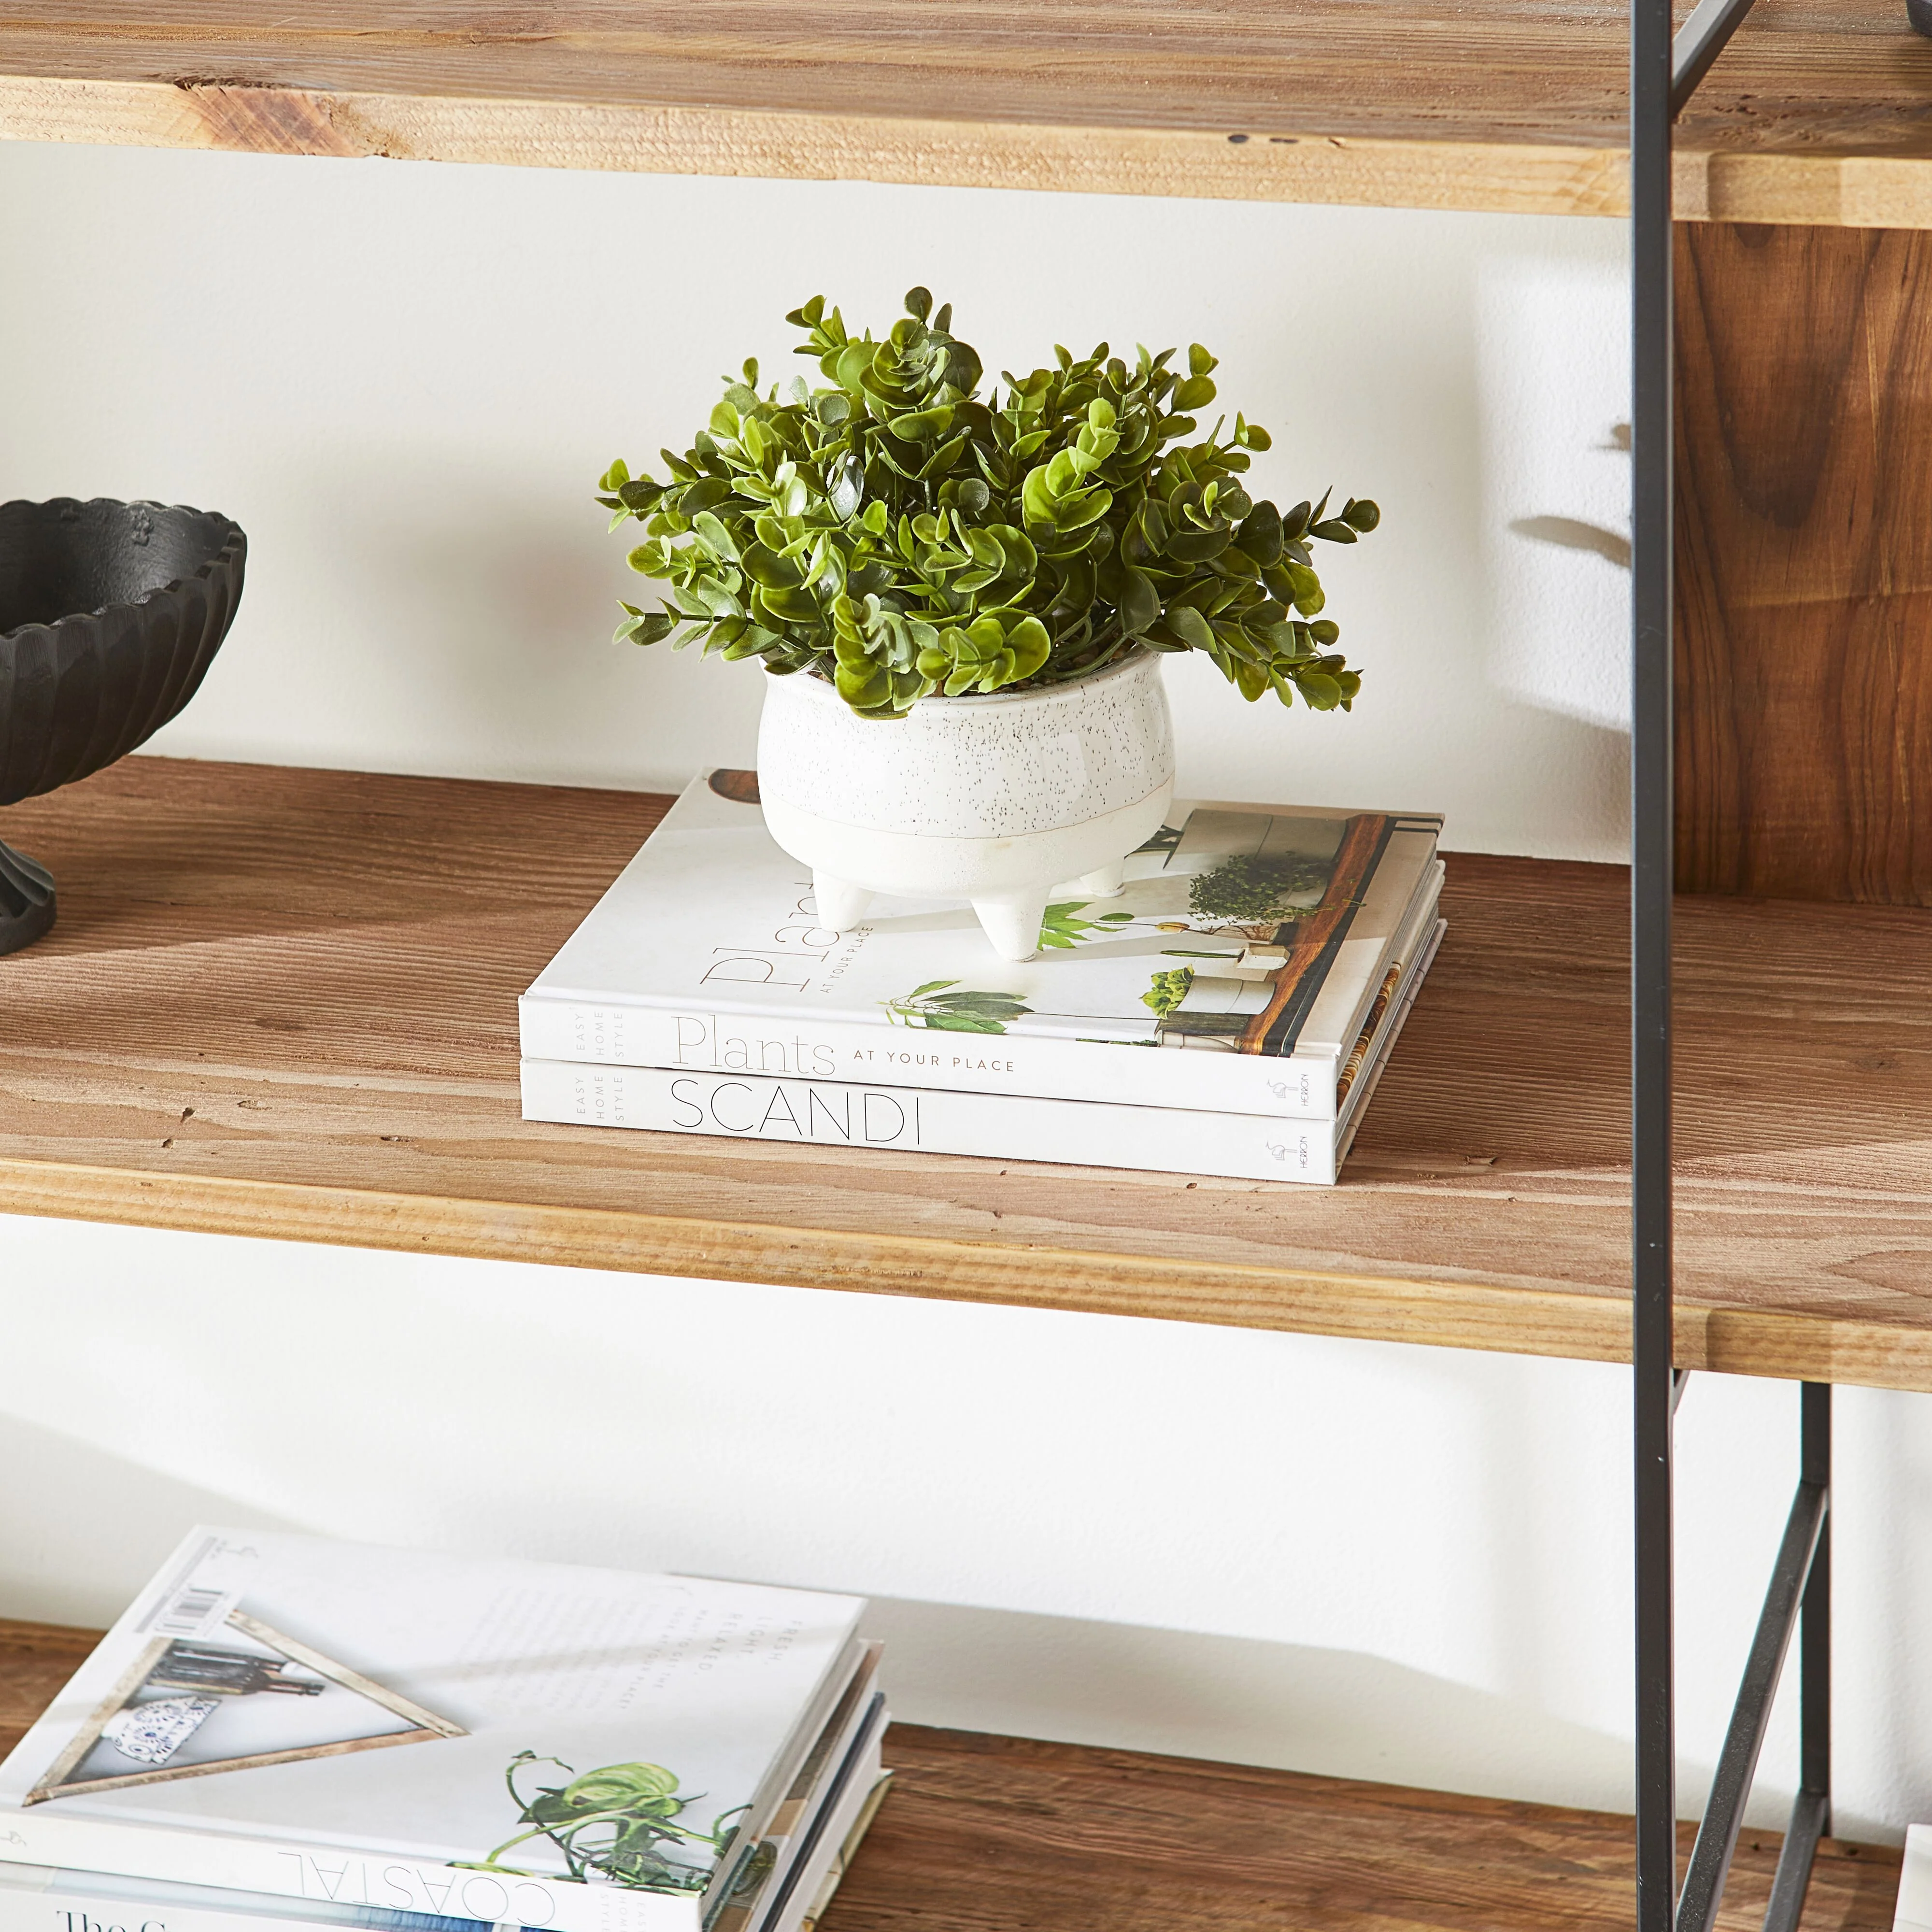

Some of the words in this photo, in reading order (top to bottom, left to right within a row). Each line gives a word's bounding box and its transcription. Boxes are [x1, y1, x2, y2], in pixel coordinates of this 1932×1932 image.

[820, 983, 834, 993] AT
[828, 957, 853, 979] YOUR
[847, 927, 873, 952] PLACE
[575, 1013, 585, 1051] EASY
[594, 1011, 604, 1055] HOME
[613, 1013, 624, 1057] STYLE
[671, 1014, 835, 1075] Plants
[853, 1050, 875, 1061] AT
[887, 1051, 939, 1066] YOUR
[952, 1057, 1014, 1072] PLACE
[575, 1078, 585, 1114] EASY
[595, 1076, 605, 1119] HOME
[614, 1077, 625, 1121] STYLE
[671, 1079, 920, 1145] SCANDI
[1300, 1074, 1308, 1107] HERRON
[1299, 1136, 1308, 1168] HERRON
[277, 1852, 555, 1927] COASTAL
